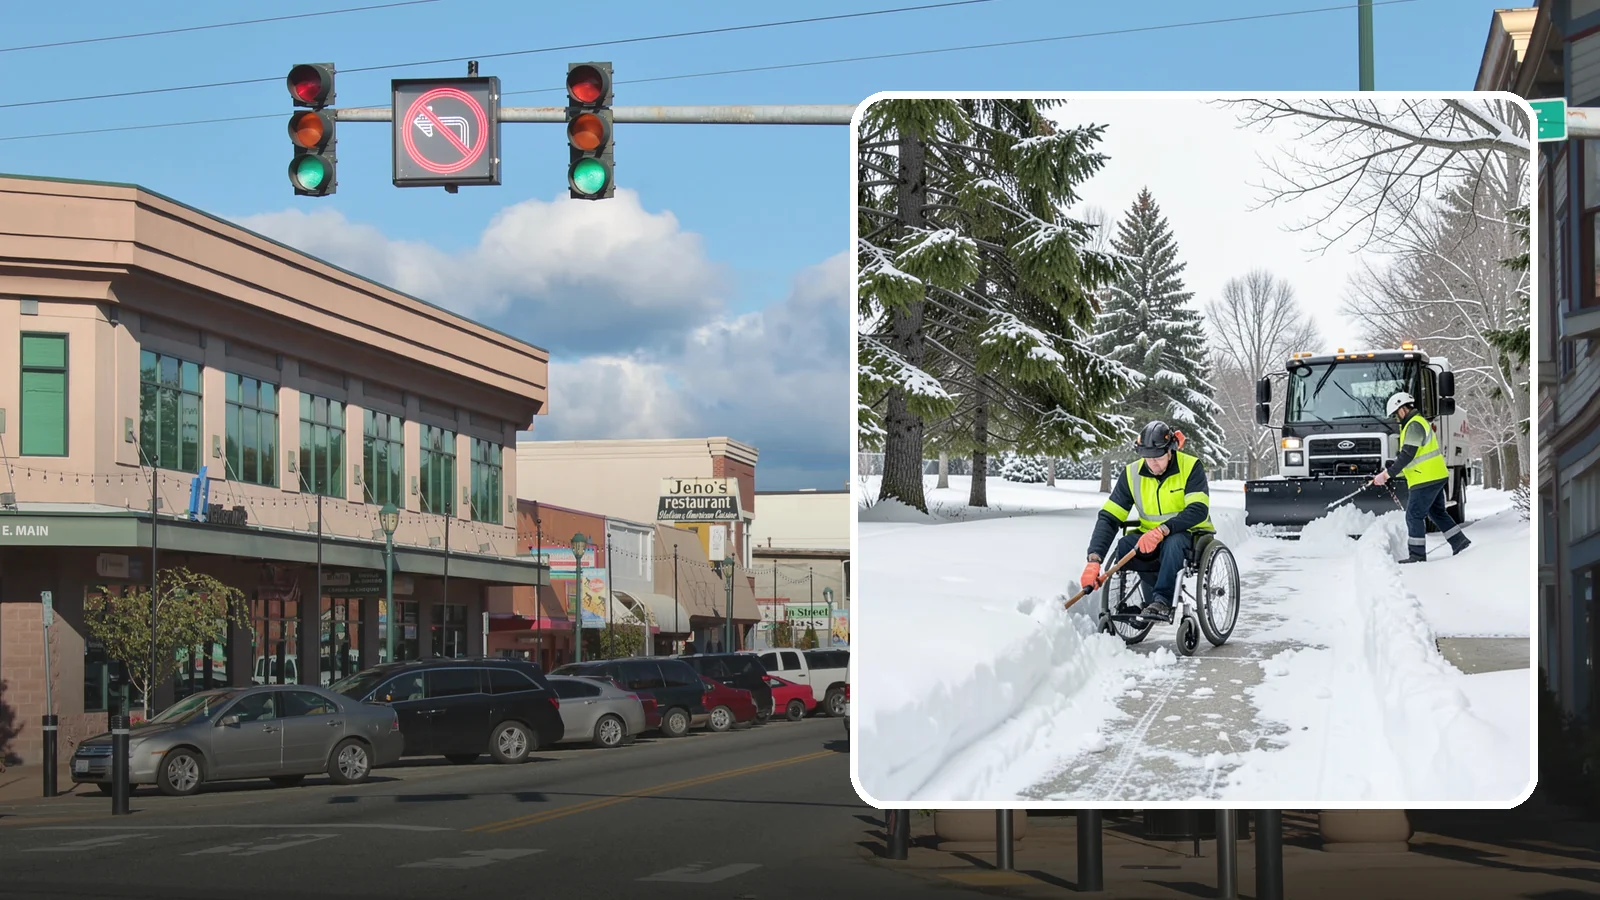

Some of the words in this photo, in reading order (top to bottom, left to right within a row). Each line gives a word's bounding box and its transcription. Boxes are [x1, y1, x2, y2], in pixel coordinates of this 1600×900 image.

[670, 480, 727, 494] Jeno's
[665, 496, 731, 509] restaurant
[658, 510, 681, 520] Italian
[686, 510, 714, 519] American
[715, 510, 737, 519] Cuisine
[2, 525, 13, 536] E.
[15, 525, 49, 536] MAIN
[797, 607, 828, 617] Street
[786, 619, 823, 627] lass
